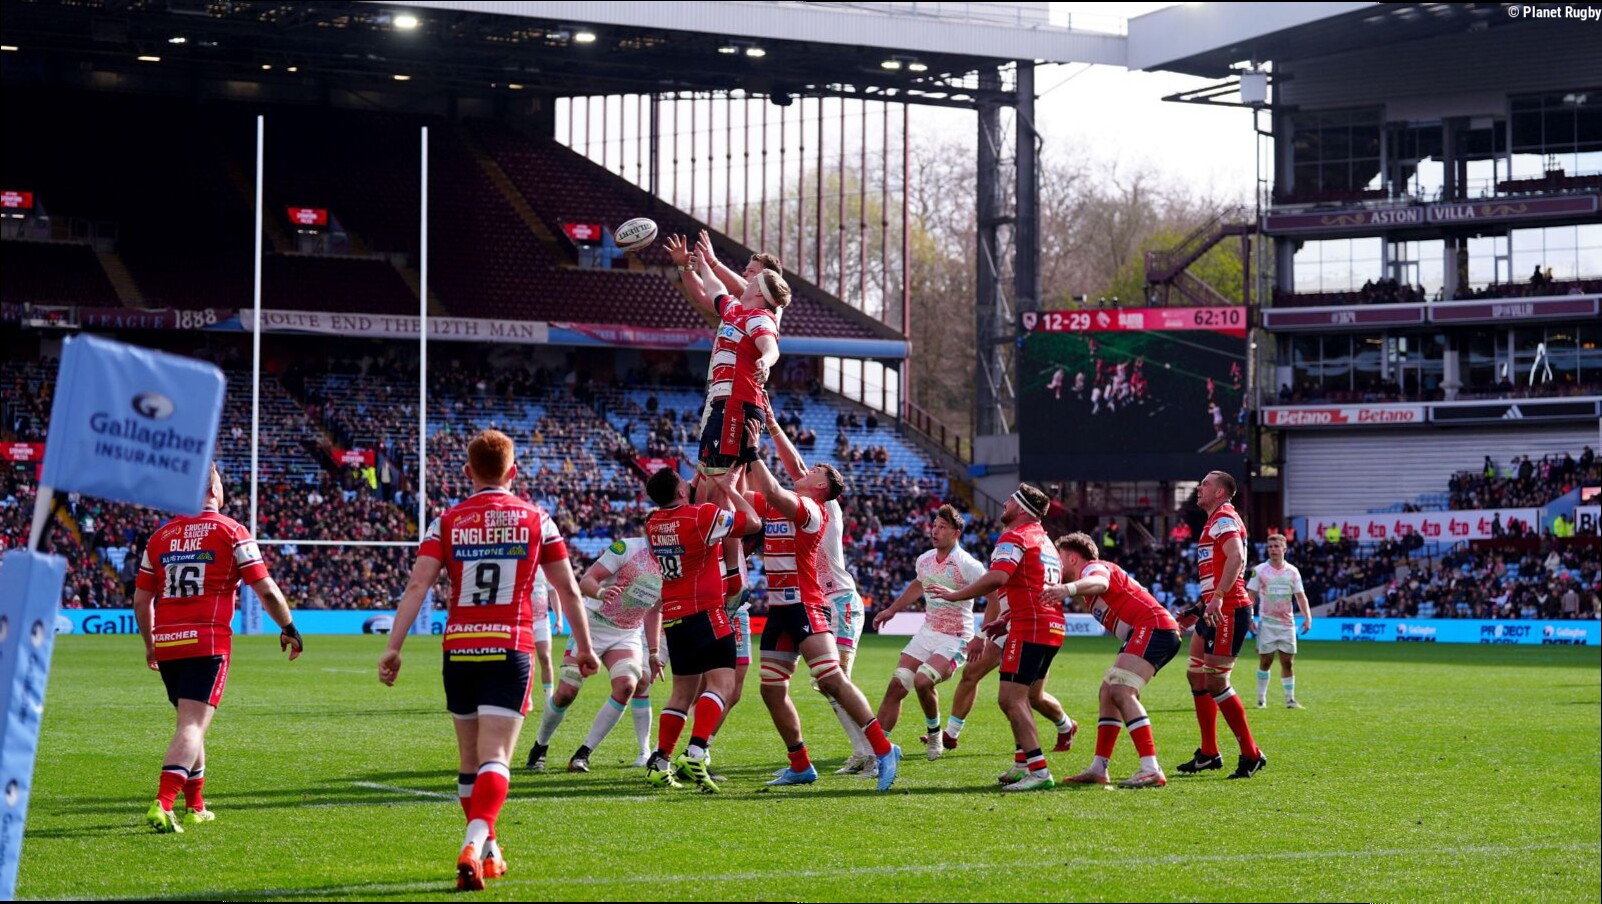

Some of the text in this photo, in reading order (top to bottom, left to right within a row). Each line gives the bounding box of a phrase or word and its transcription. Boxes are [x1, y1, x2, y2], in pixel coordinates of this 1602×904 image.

[1371, 206, 1475, 223] ASTON VILLA
[88, 308, 218, 328] LEAGUE 1888
[1043, 313, 1091, 331] 12-29
[1194, 310, 1240, 325] 62:10
[331, 316, 372, 331] END
[383, 317, 420, 333] THE
[432, 320, 479, 335] 12TH
[489, 323, 534, 338] MAN
[1277, 411, 1332, 425] Betano
[1357, 409, 1414, 423] Betano
[90, 412, 206, 455] Gallagher
[95, 441, 192, 475] INSURANCE
[485, 509, 528, 519] CRUCIALS
[485, 517, 519, 527] SAUCES
[184, 529, 209, 539] SAUCES
[185, 523, 217, 532] CRUCIALS
[451, 527, 529, 545] ENGLEFIELD
[170, 537, 203, 552] BLAKE
[455, 548, 504, 558] ALLSTONE
[167, 565, 200, 598] 16
[472, 562, 501, 606] 9
[82, 615, 140, 634] Gall
